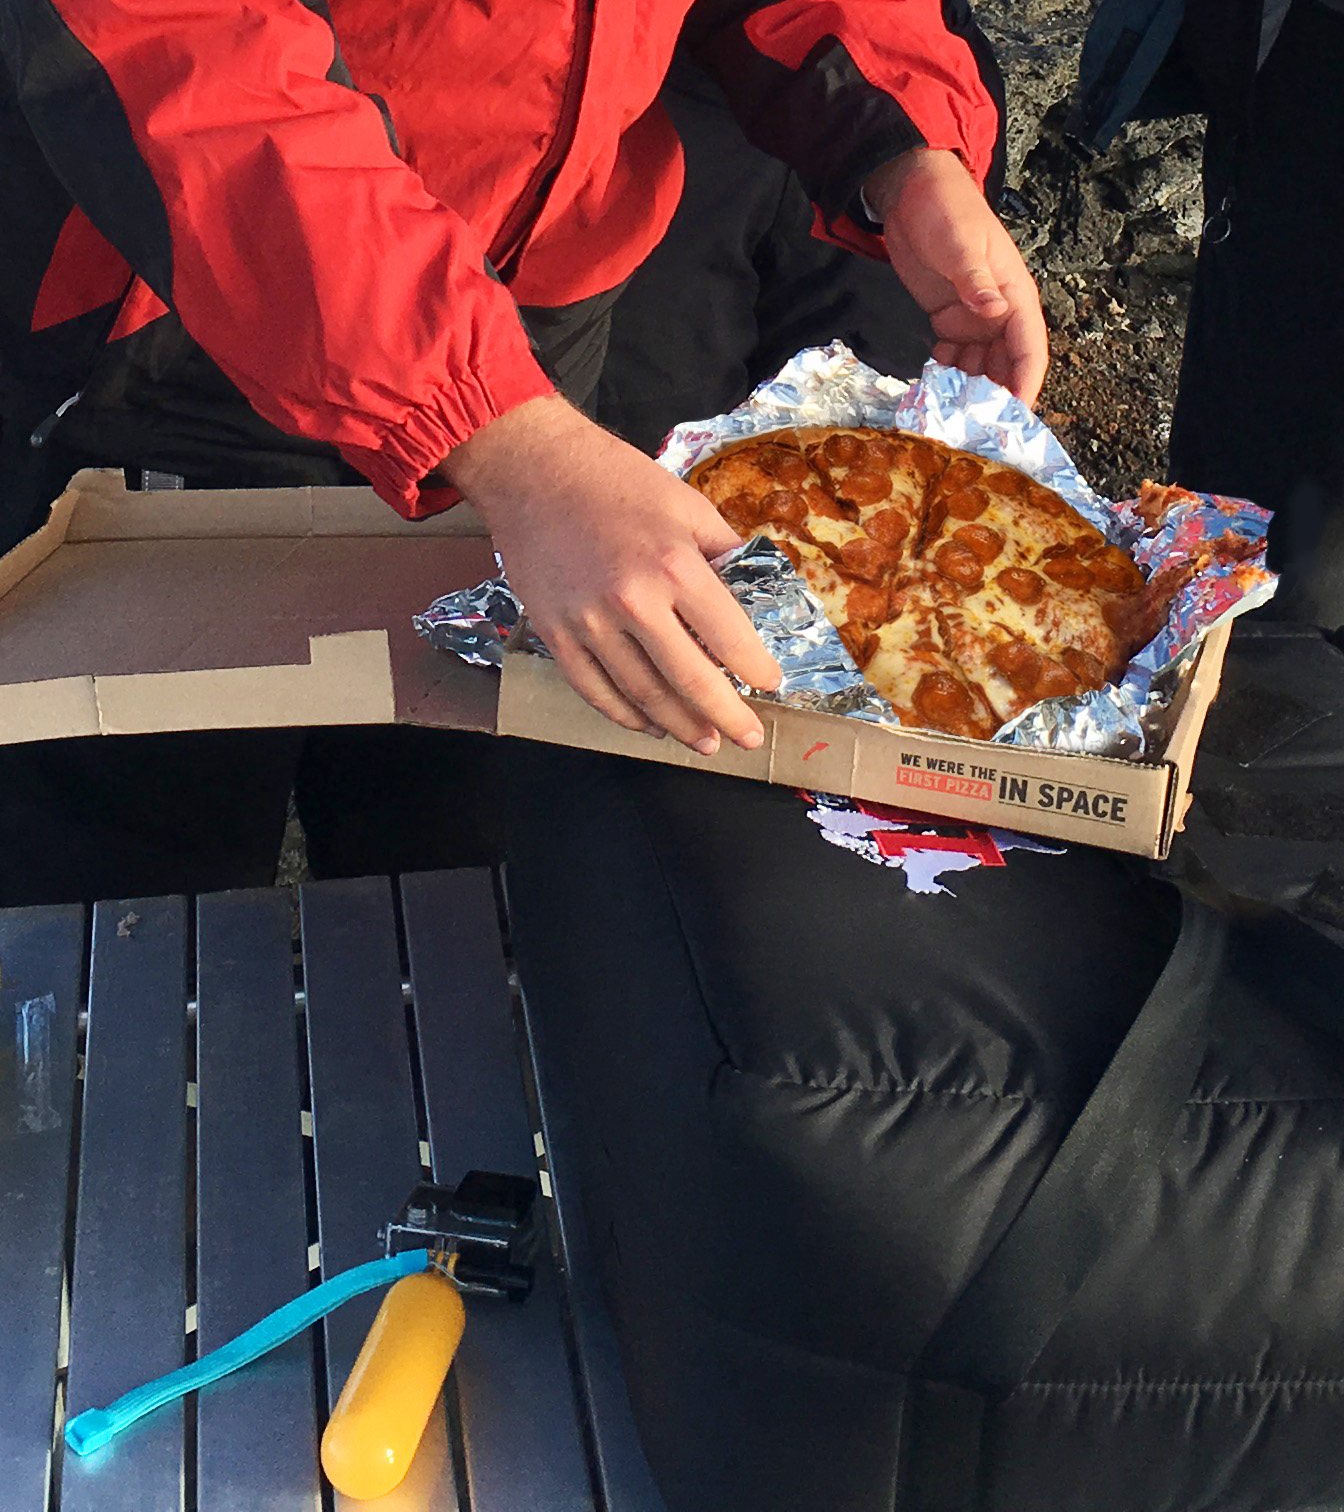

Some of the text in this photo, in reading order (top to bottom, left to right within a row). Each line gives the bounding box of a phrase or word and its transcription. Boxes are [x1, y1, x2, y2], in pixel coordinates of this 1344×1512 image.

[900, 752, 997, 782] WE WERE THE
[898, 769, 991, 800] FIRST PIZZA
[999, 775, 1128, 823] IN SPACE
